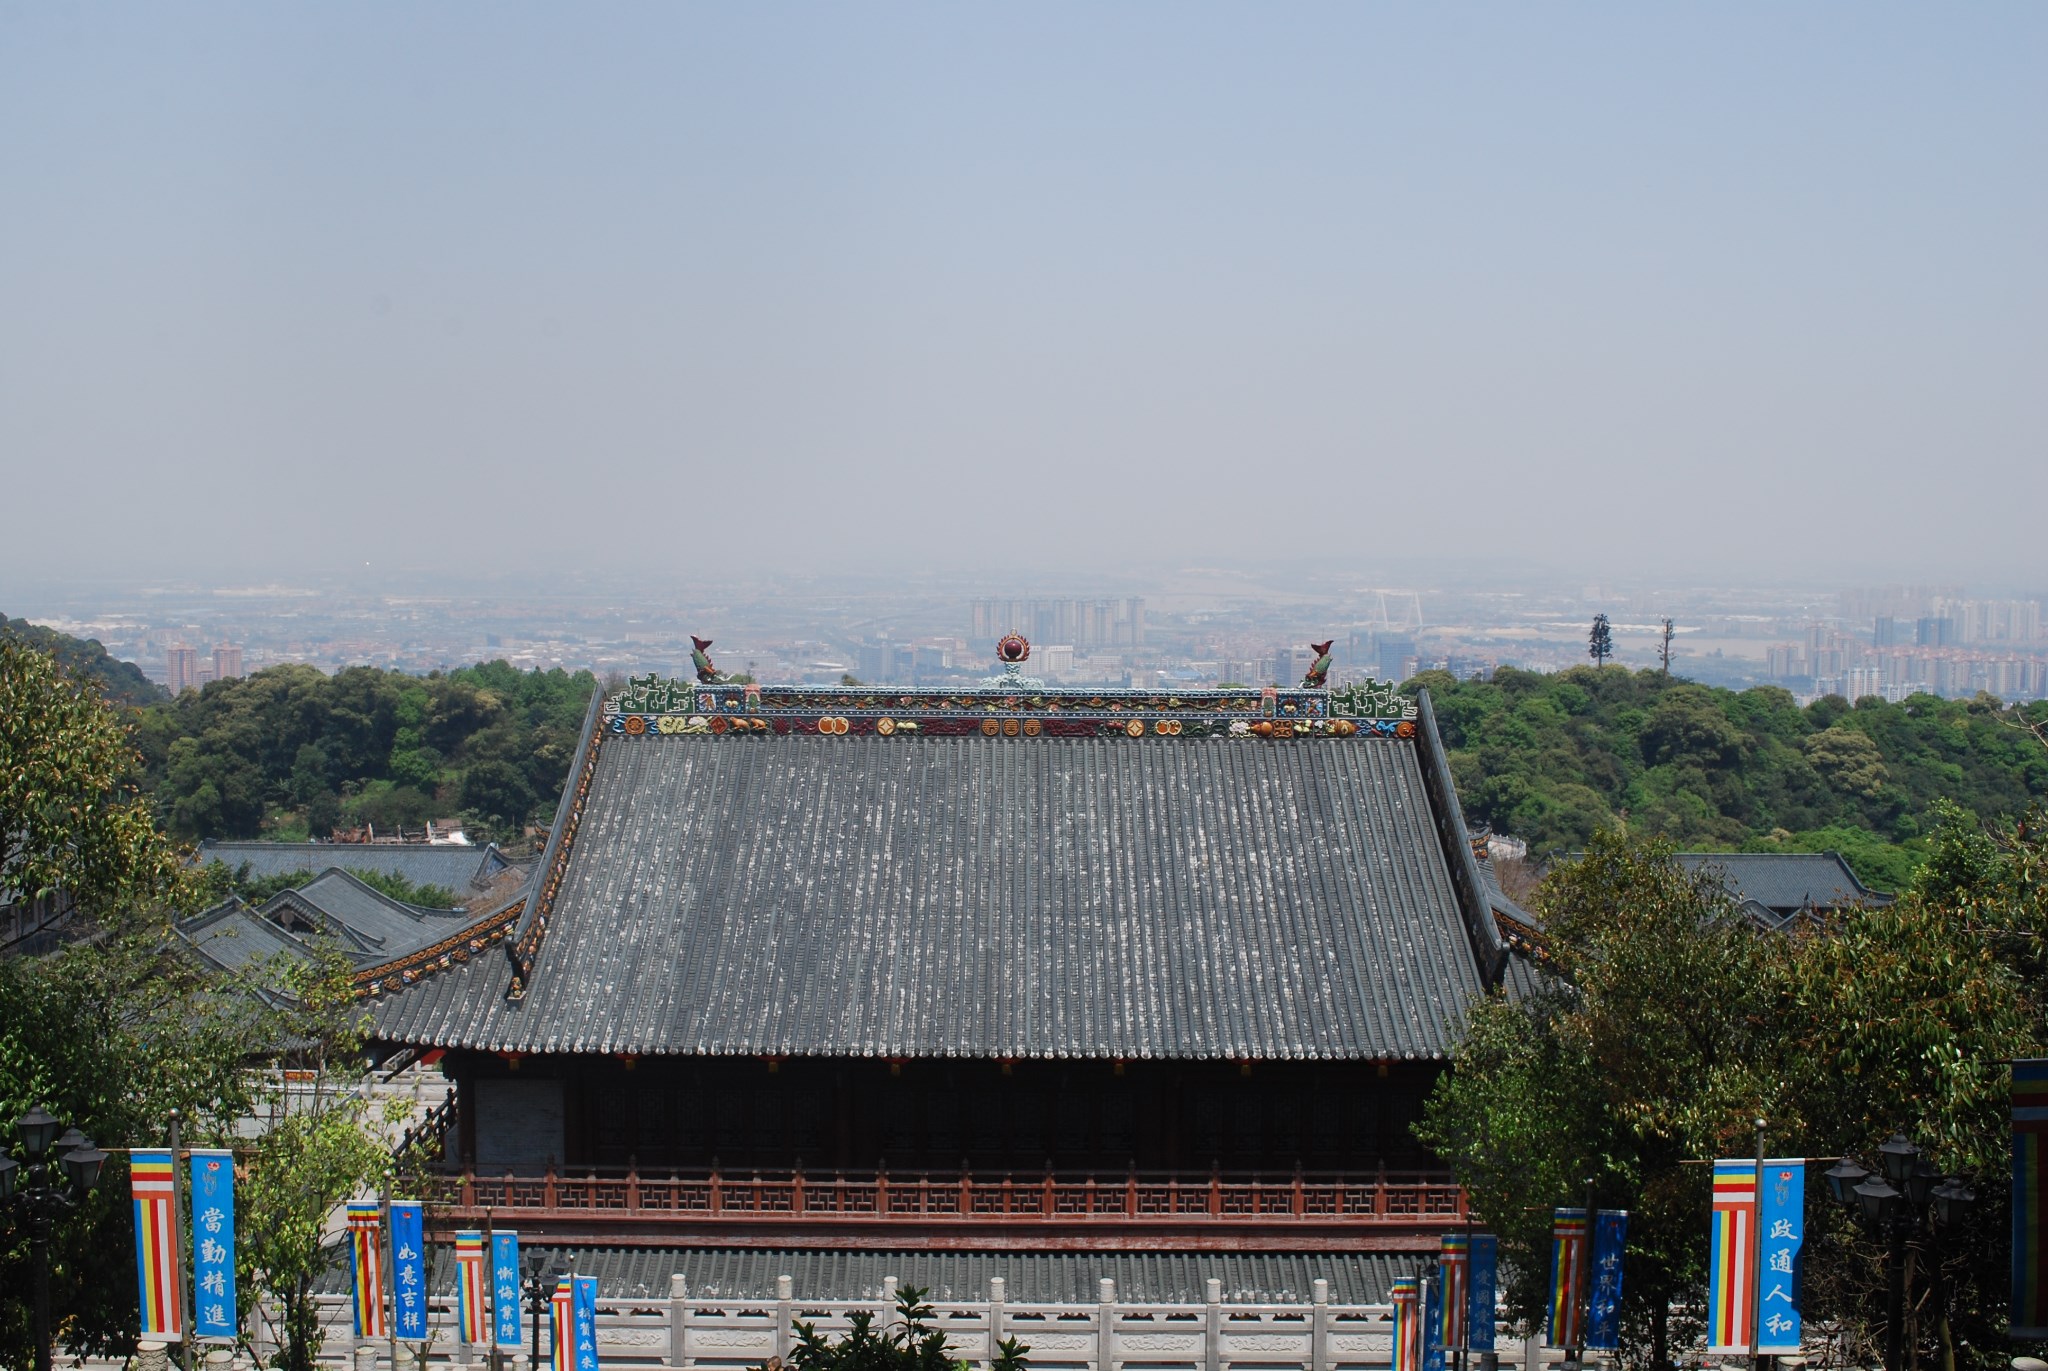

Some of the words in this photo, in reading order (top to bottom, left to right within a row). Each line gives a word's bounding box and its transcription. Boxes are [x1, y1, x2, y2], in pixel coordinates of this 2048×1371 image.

[200, 1207, 230, 1327] 當勤精進
[398, 1241, 421, 1332] 如意吉祥
[1595, 1253, 1619, 1340] 世界和平
[1765, 1218, 1799, 1337] 政通人和
